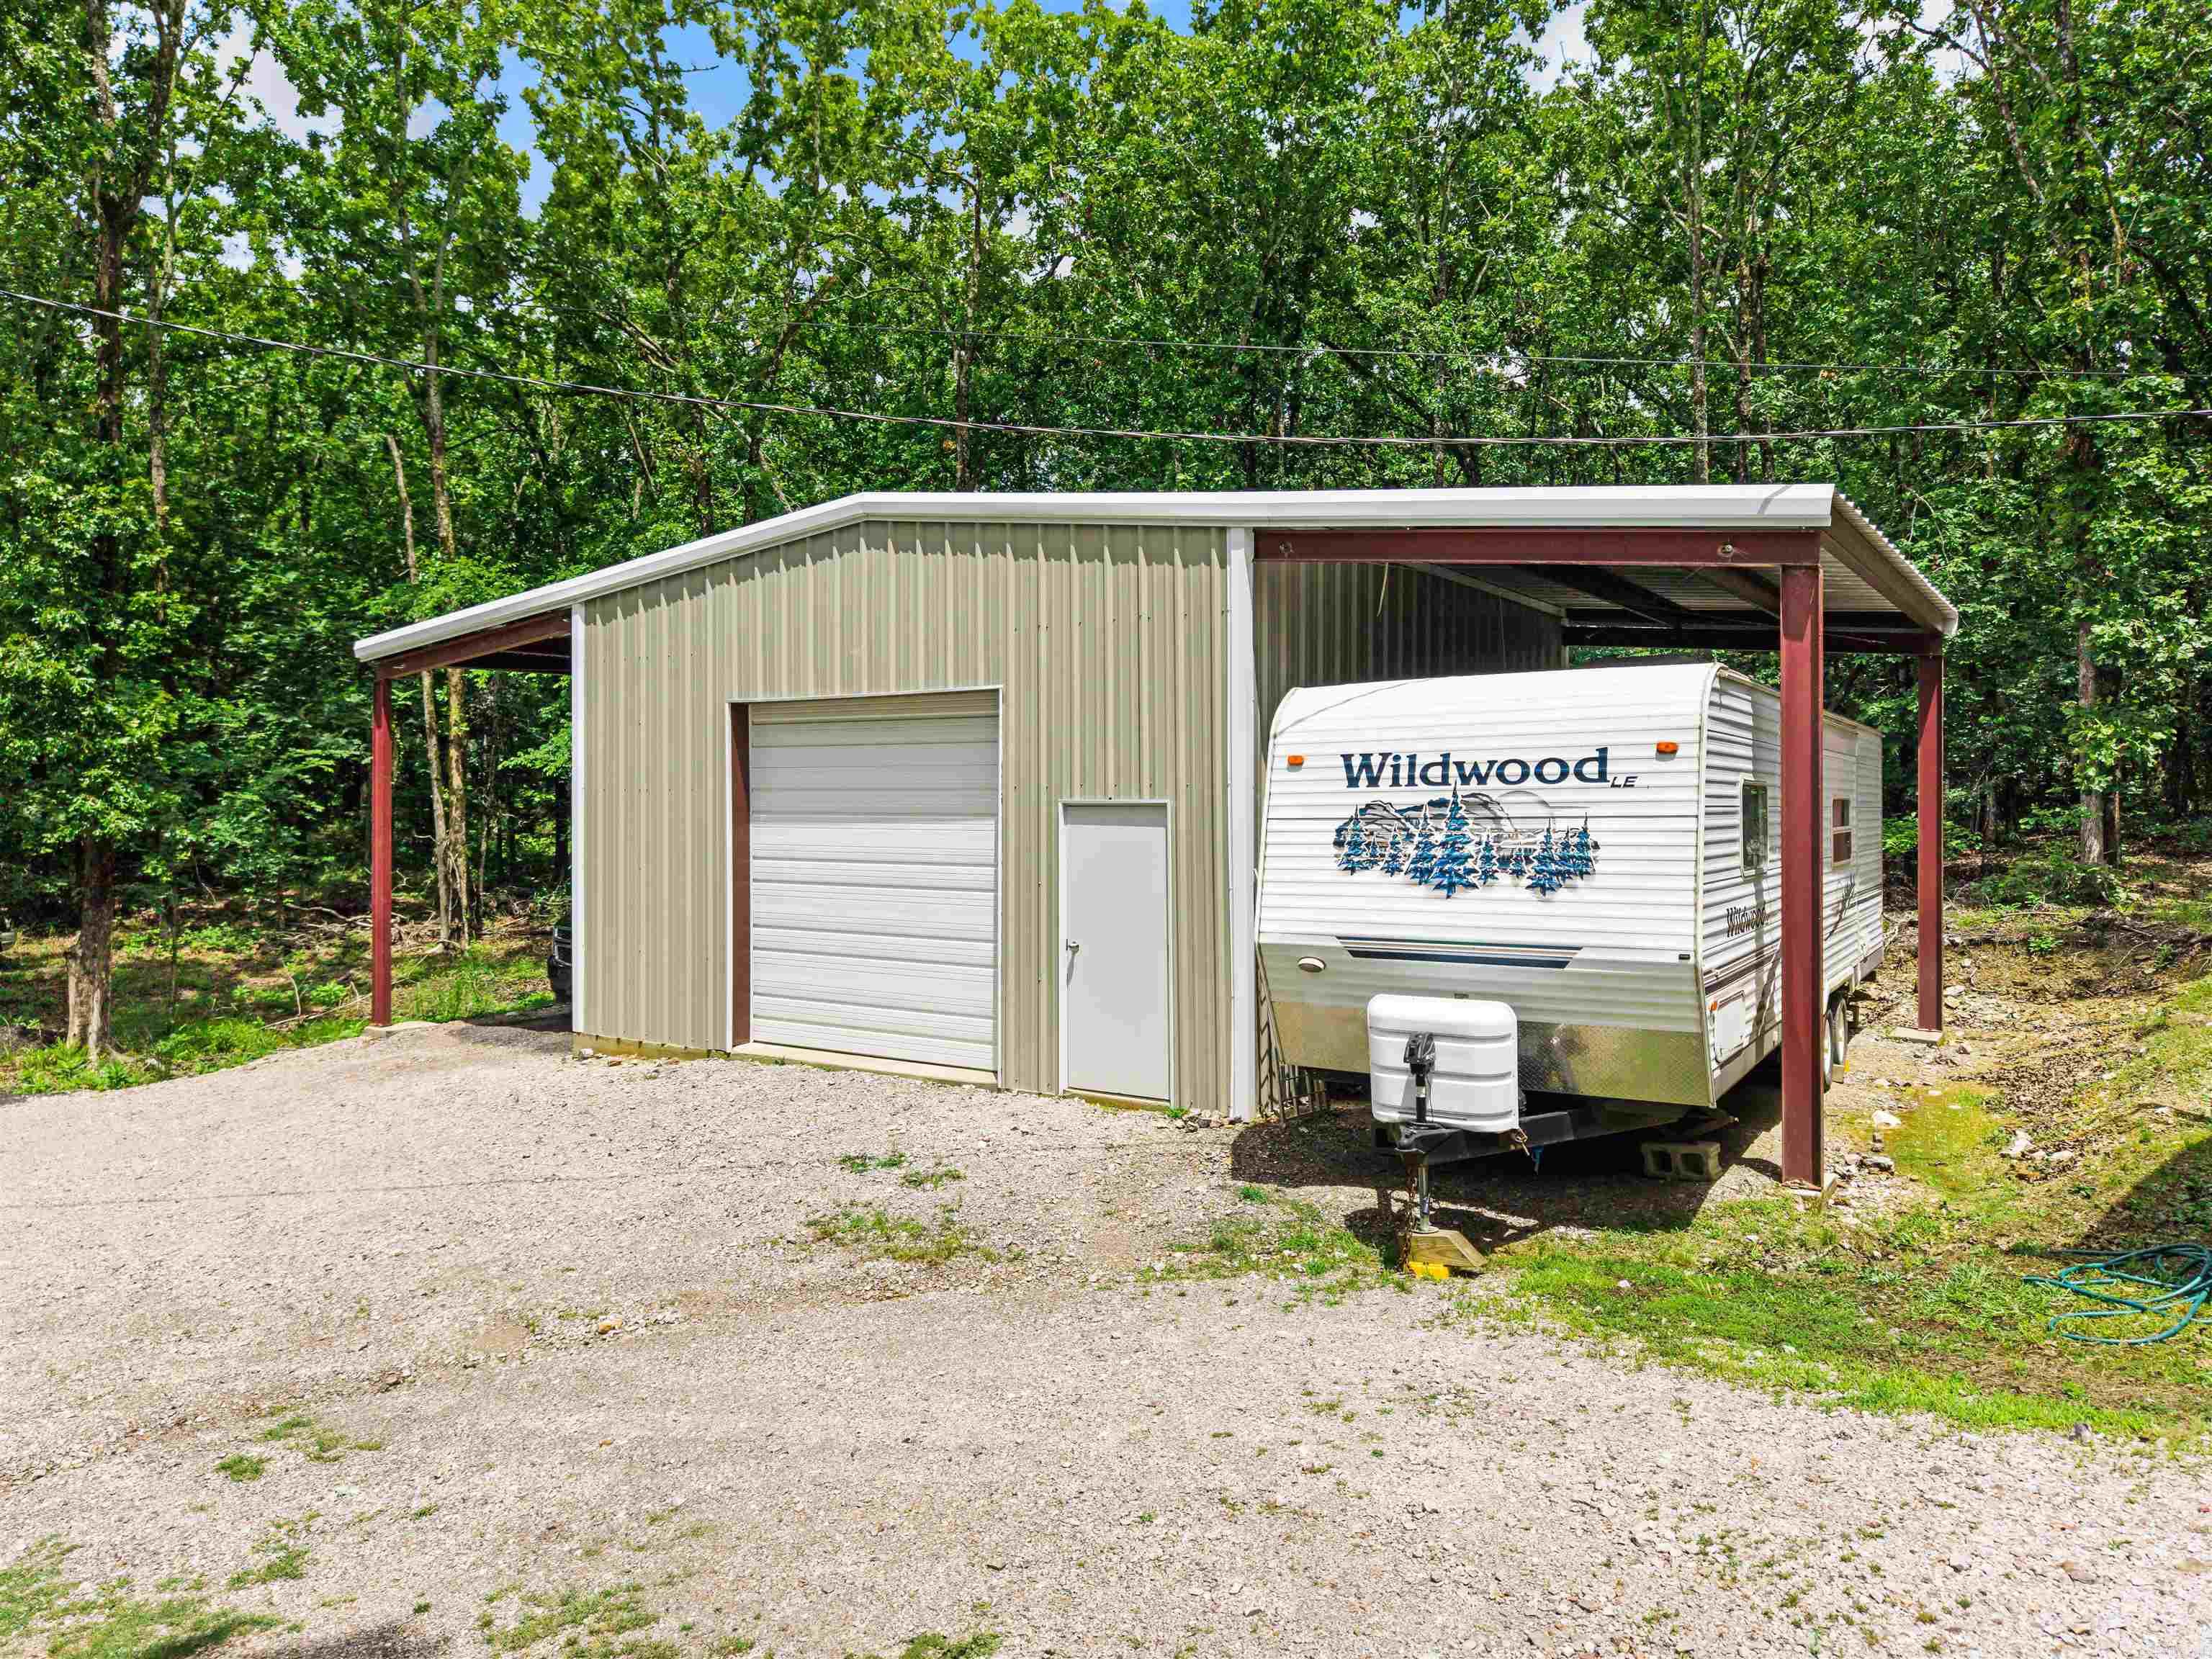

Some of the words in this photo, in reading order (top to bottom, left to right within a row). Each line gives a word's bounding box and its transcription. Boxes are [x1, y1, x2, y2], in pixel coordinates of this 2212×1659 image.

[1340, 747, 1610, 788] Wildwood
[1610, 776, 1638, 788] LE
[1726, 900, 1766, 938] Wildwood
